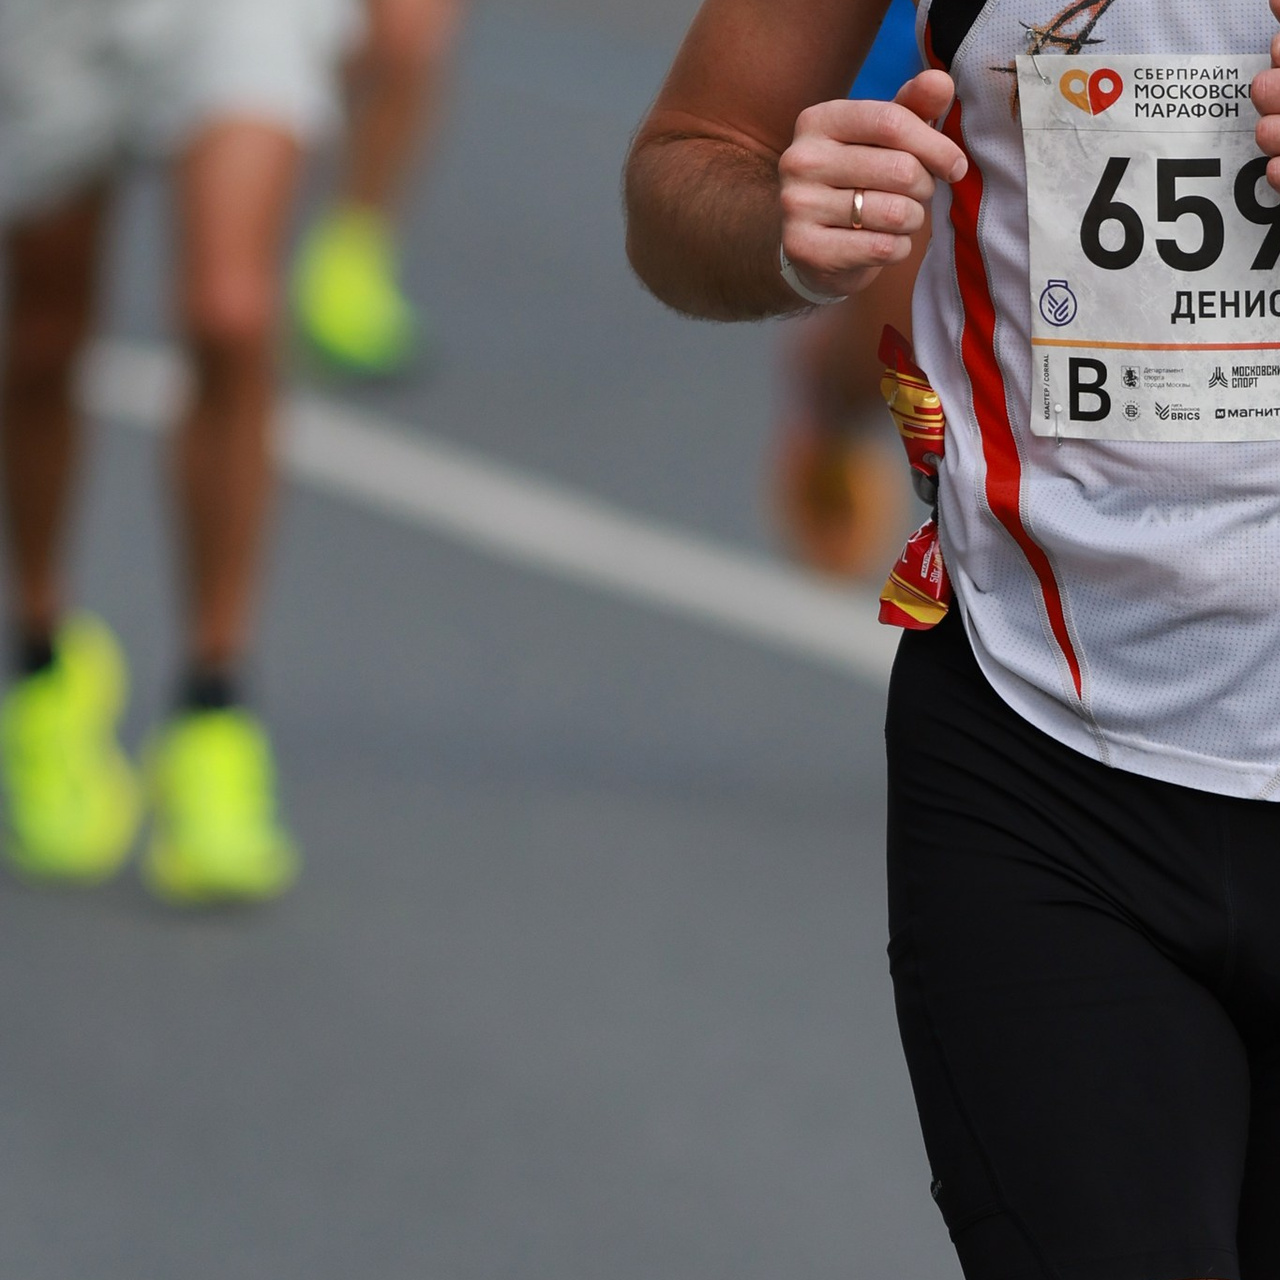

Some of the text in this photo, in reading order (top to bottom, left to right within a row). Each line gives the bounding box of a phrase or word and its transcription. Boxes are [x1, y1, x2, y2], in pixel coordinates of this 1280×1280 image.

[1134, 66, 1239, 80] СБЕРПРАЙМ
[1134, 83, 1252, 99] МОСКОВСК
[1135, 102, 1239, 118] МАРАФОН
[1231, 377, 1258, 389] СПОРТ
[1171, 412, 1200, 421] BRICS
